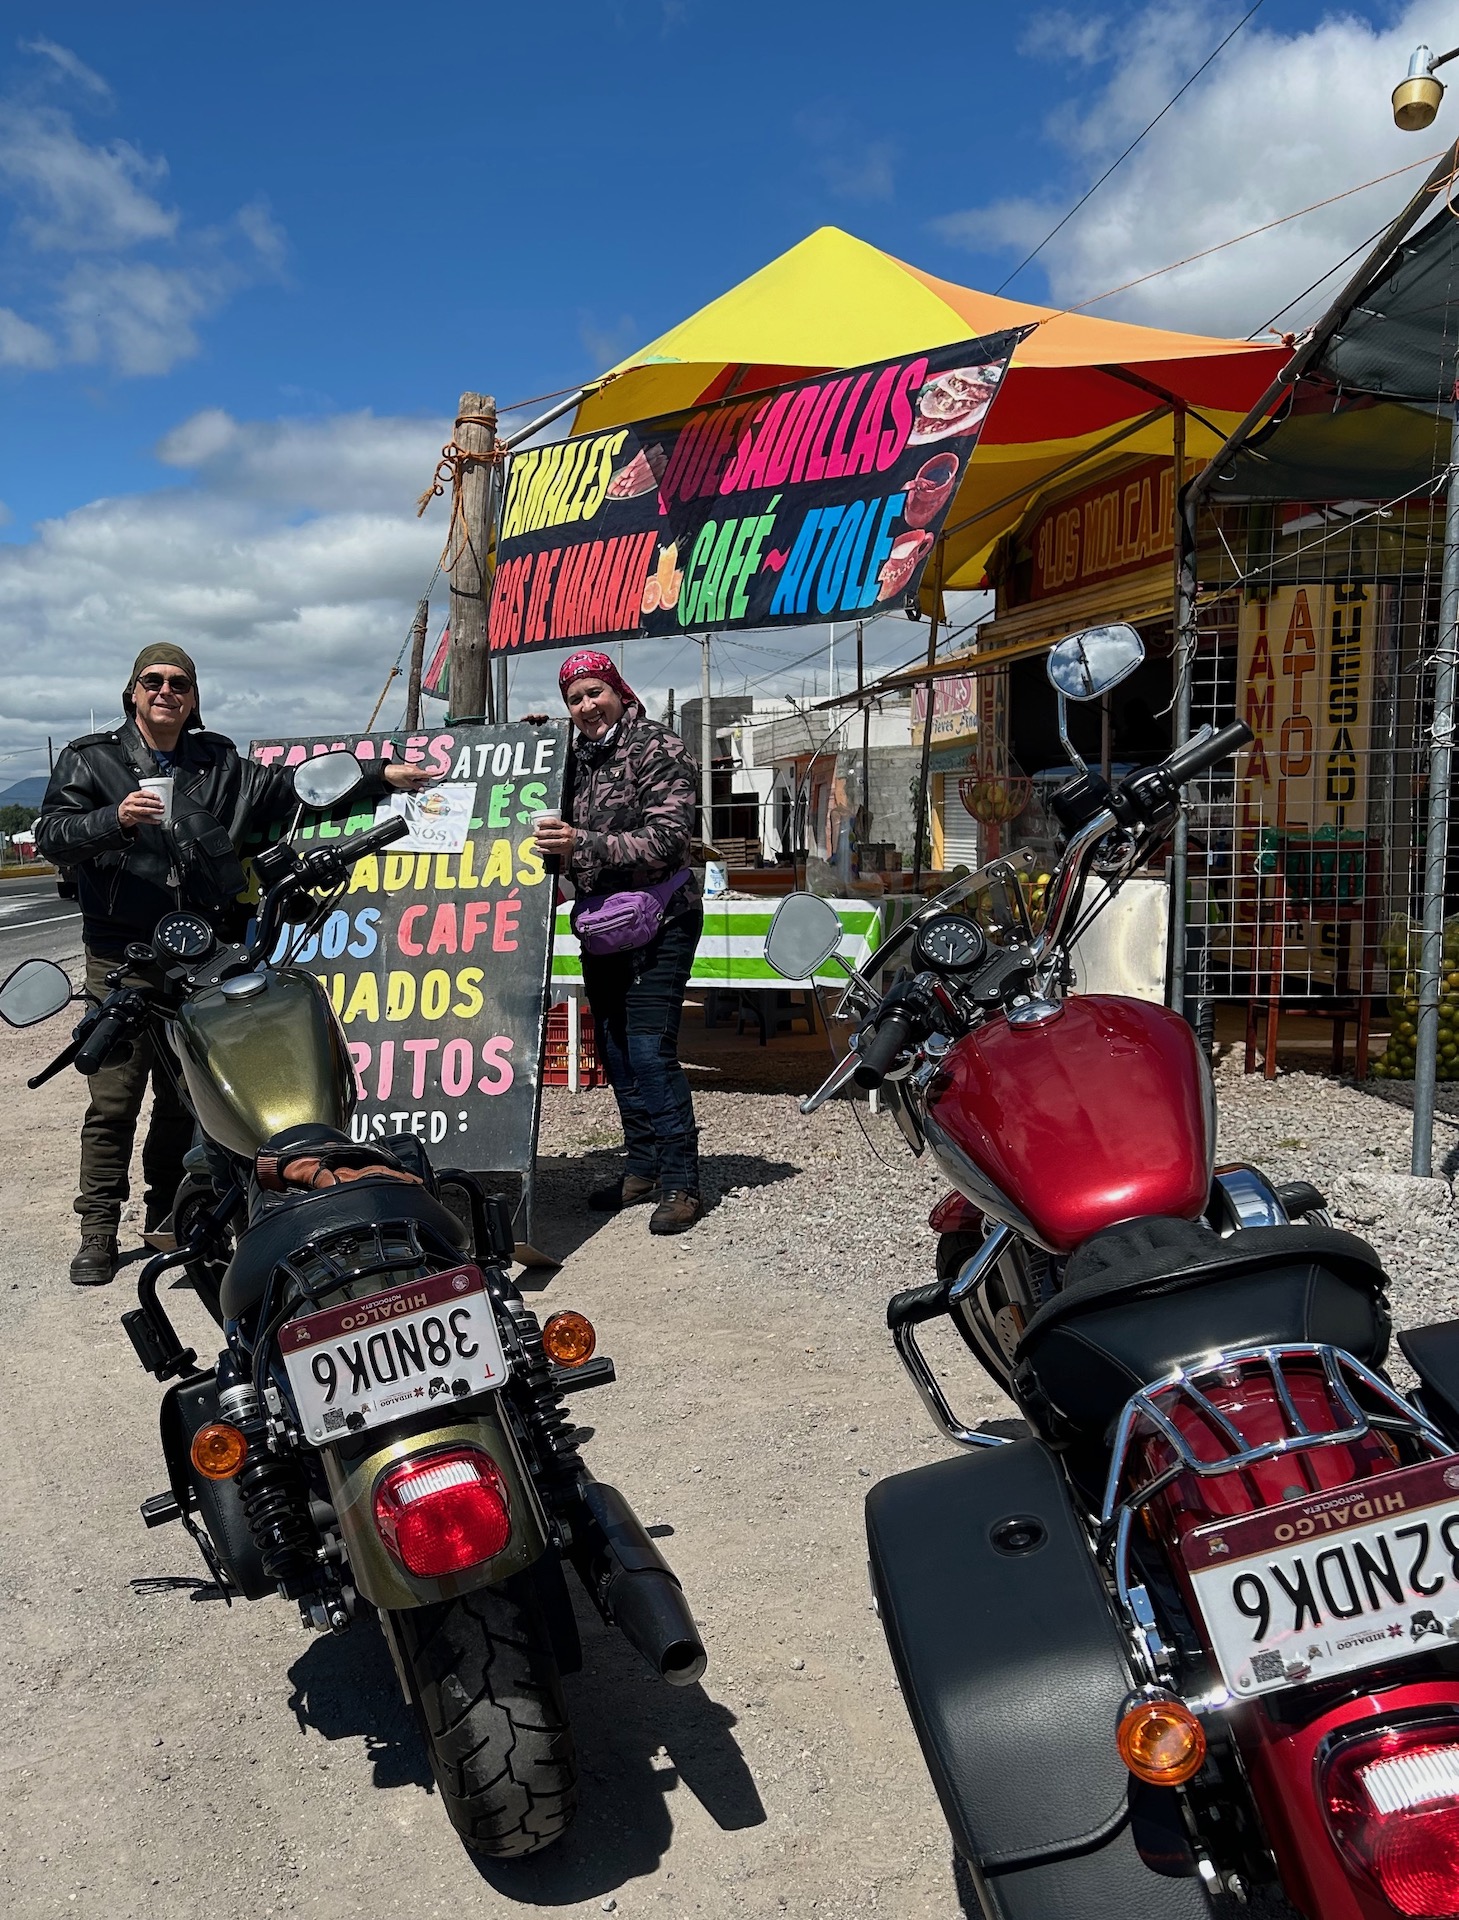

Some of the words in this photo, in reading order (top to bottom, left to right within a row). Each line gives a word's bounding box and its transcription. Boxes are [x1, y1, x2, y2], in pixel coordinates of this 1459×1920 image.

[658, 357, 928, 515] QUESADILLAS
[501, 429, 629, 541] TAMALES
[677, 494, 783, 626] CAFÉ
[770, 492, 907, 615] ATOLE
[1043, 508, 1081, 589] LOS
[1082, 466, 1174, 577] MOLCAJE
[524, 548, 561, 644] DE
[549, 531, 659, 639] NARANJA
[912, 677, 972, 723] NEVES
[1277, 589, 1316, 834] ATOL
[451, 739, 556, 779] ATOLE
[397, 887, 522, 957] CAFÉ
[341, 1293, 428, 1330] HIDALGO
[360, 1294, 402, 1311] MOTOCICLETA
[311, 1308, 479, 1403] 38NDK6
[1274, 1491, 1406, 1541] HIDALGO
[1303, 1492, 1365, 1514] MOTOCICLETA
[1337, 1632, 1386, 1650] HIDALGO
